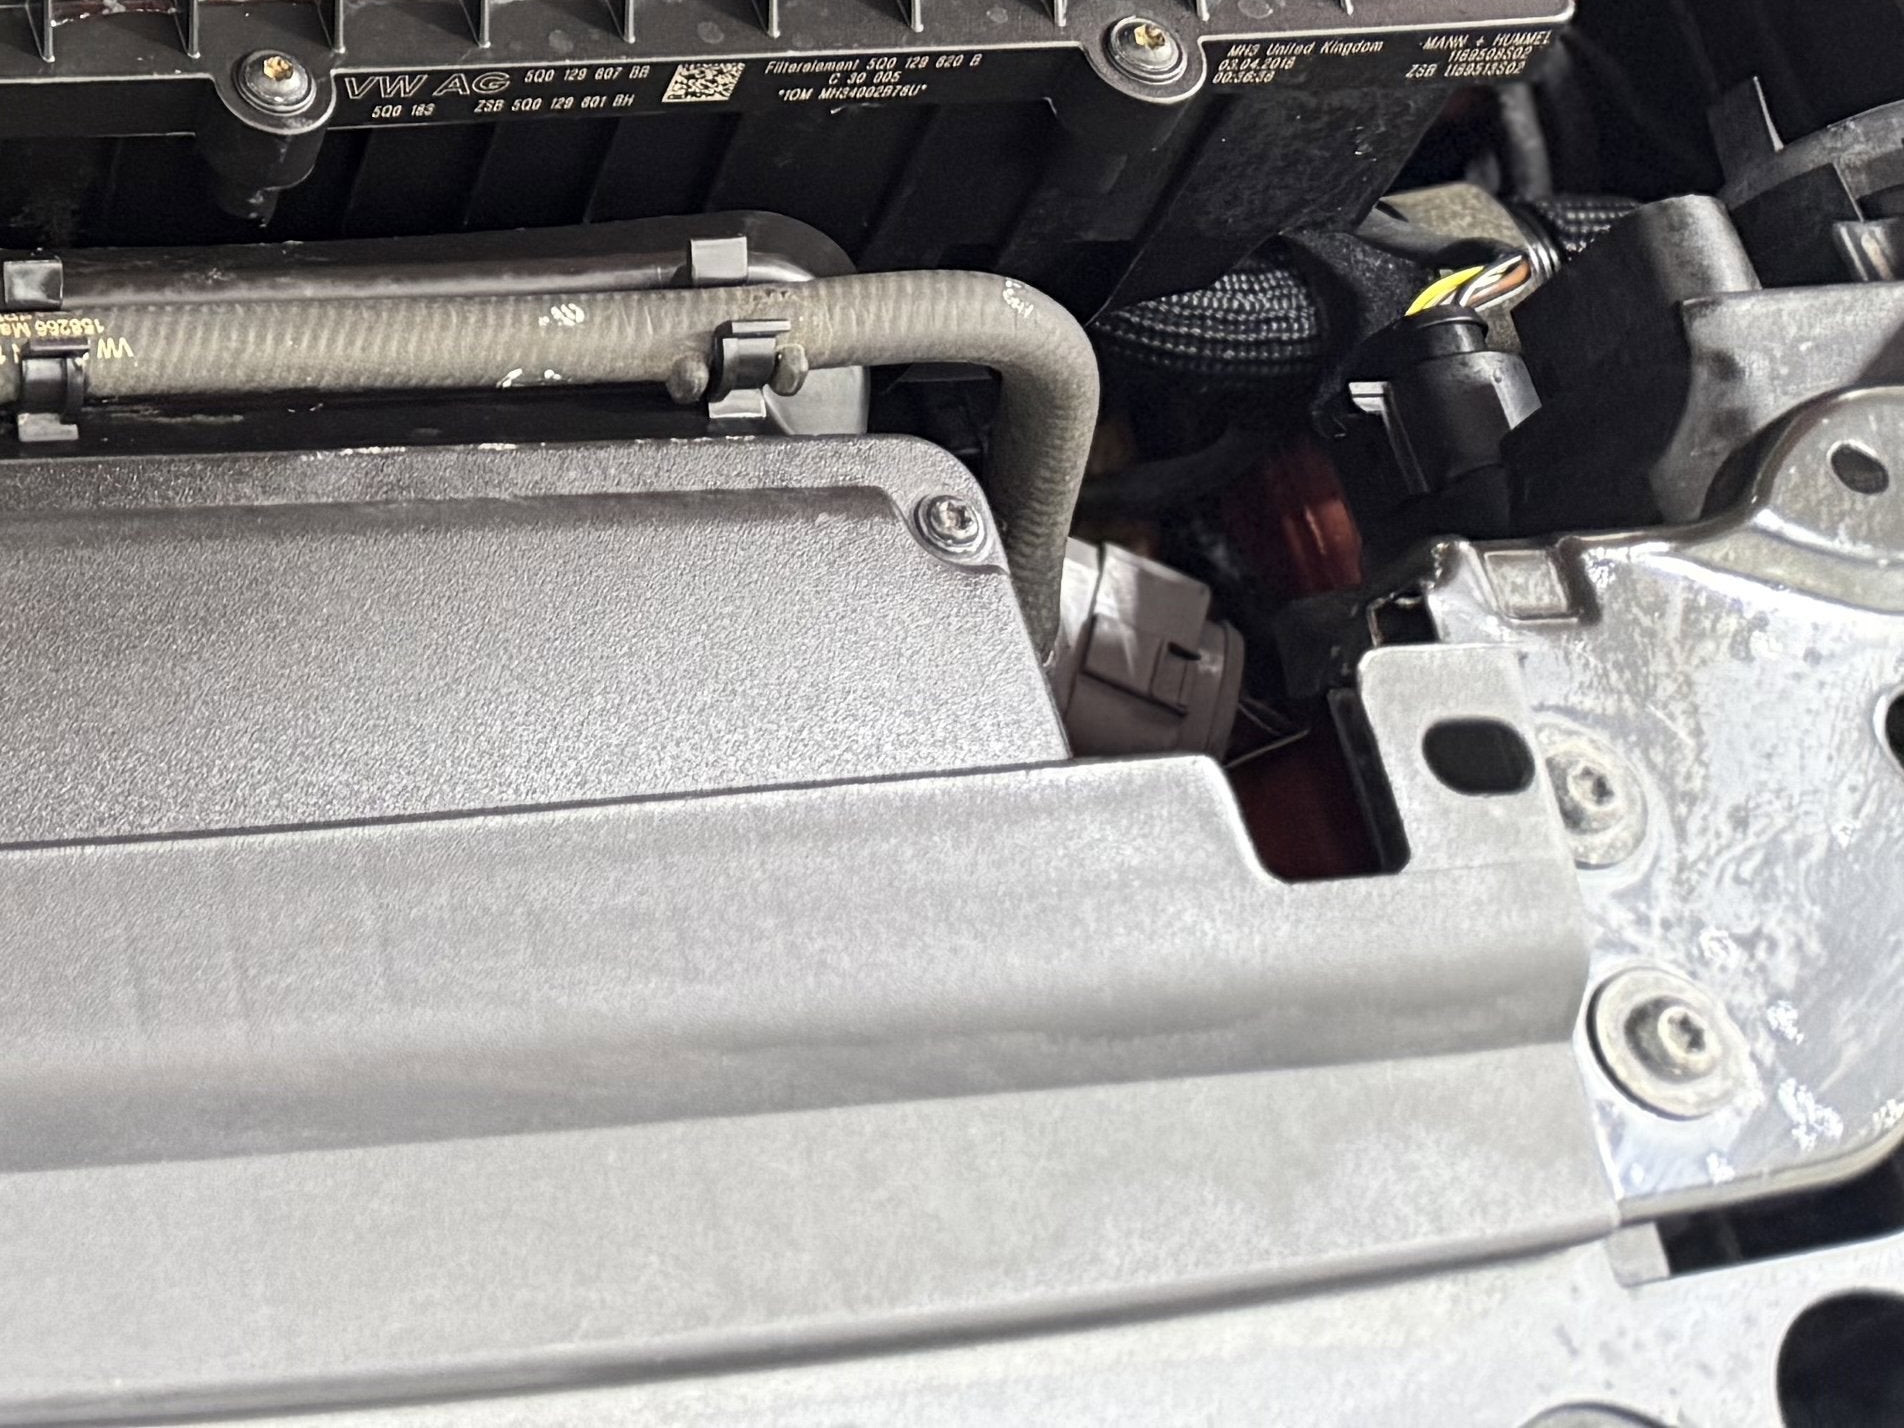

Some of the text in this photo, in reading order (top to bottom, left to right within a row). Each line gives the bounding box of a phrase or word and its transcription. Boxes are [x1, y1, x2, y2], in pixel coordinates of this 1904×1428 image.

[1266, 42, 1313, 56] United
[1319, 40, 1384, 56] Kingdom
[1423, 34, 1468, 49] MANN
[1492, 30, 1553, 47] HUMMEL
[764, 58, 860, 75] Filterelement
[866, 56, 897, 70] 5Q0
[344, 74, 428, 99] VW
[433, 71, 510, 96] AG
[524, 69, 554, 83] 5Q0
[563, 67, 587, 82] 129
[829, 73, 840, 85] C
[372, 104, 402, 119] 5Q0
[511, 97, 542, 112] 5Q0
[550, 96, 574, 111] 129
[97, 336, 134, 360] VW
